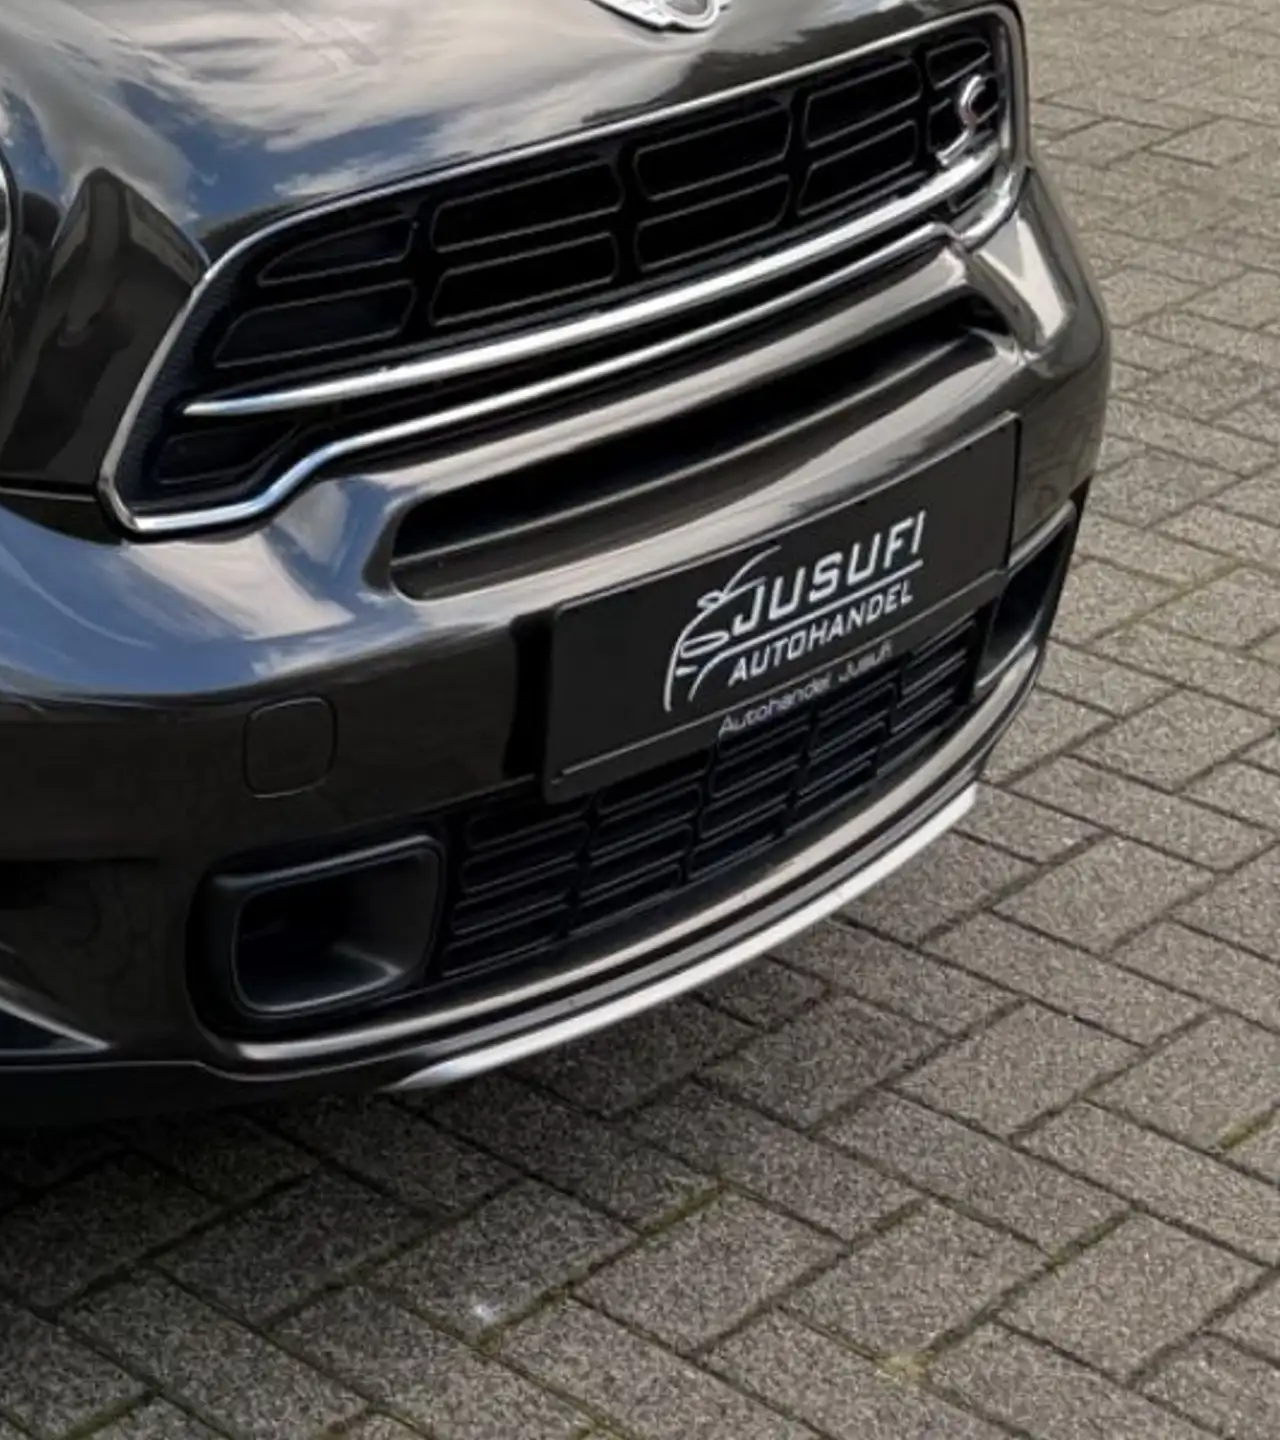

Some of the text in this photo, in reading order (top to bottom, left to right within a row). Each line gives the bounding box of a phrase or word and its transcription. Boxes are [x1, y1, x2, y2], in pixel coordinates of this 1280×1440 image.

[729, 509, 928, 635] JUSUFI
[727, 579, 915, 688] AUTOHANDEL
[718, 671, 832, 739] Autohandel
